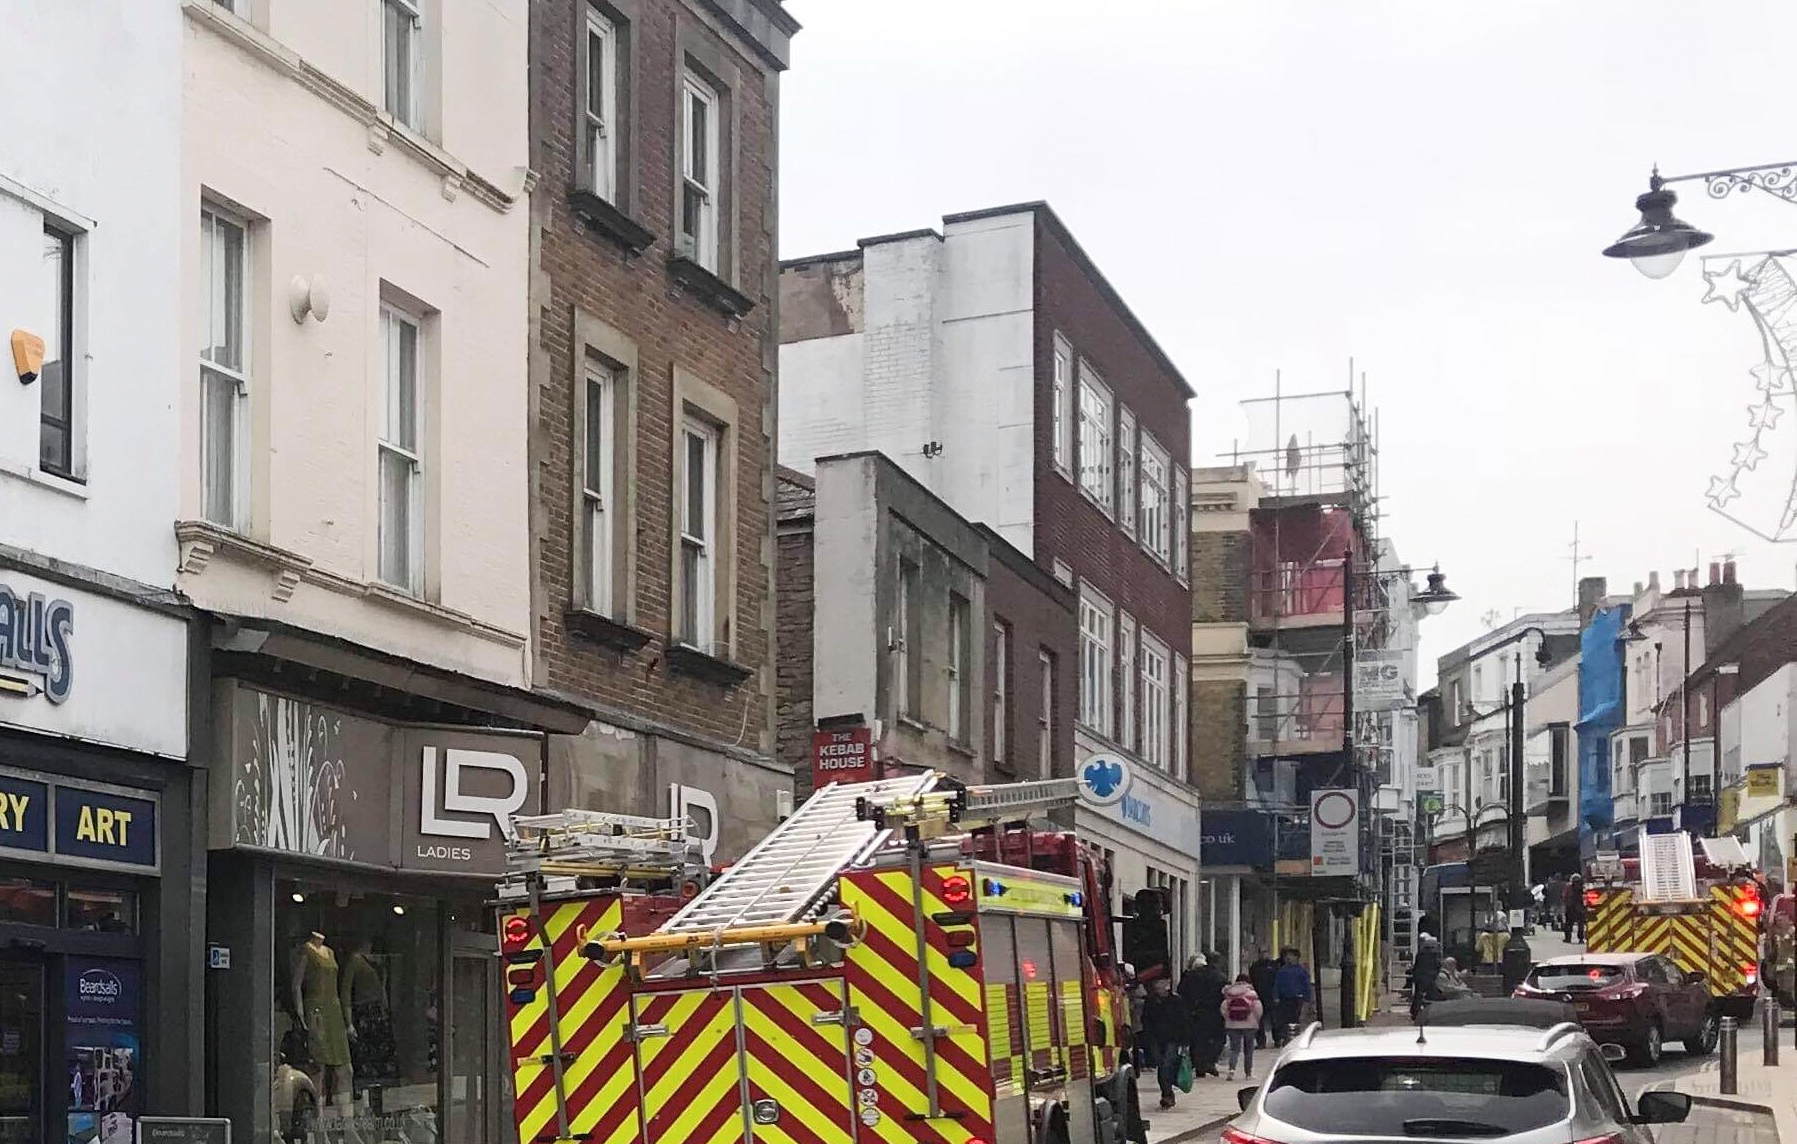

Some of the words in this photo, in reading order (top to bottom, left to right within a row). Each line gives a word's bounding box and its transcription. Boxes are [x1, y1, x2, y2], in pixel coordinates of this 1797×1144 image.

[832, 733, 852, 742] THE
[819, 743, 865, 757] KEBAB
[819, 757, 865, 770] HOUSE
[76, 805, 132, 847] ART
[417, 845, 471, 861] LADIES
